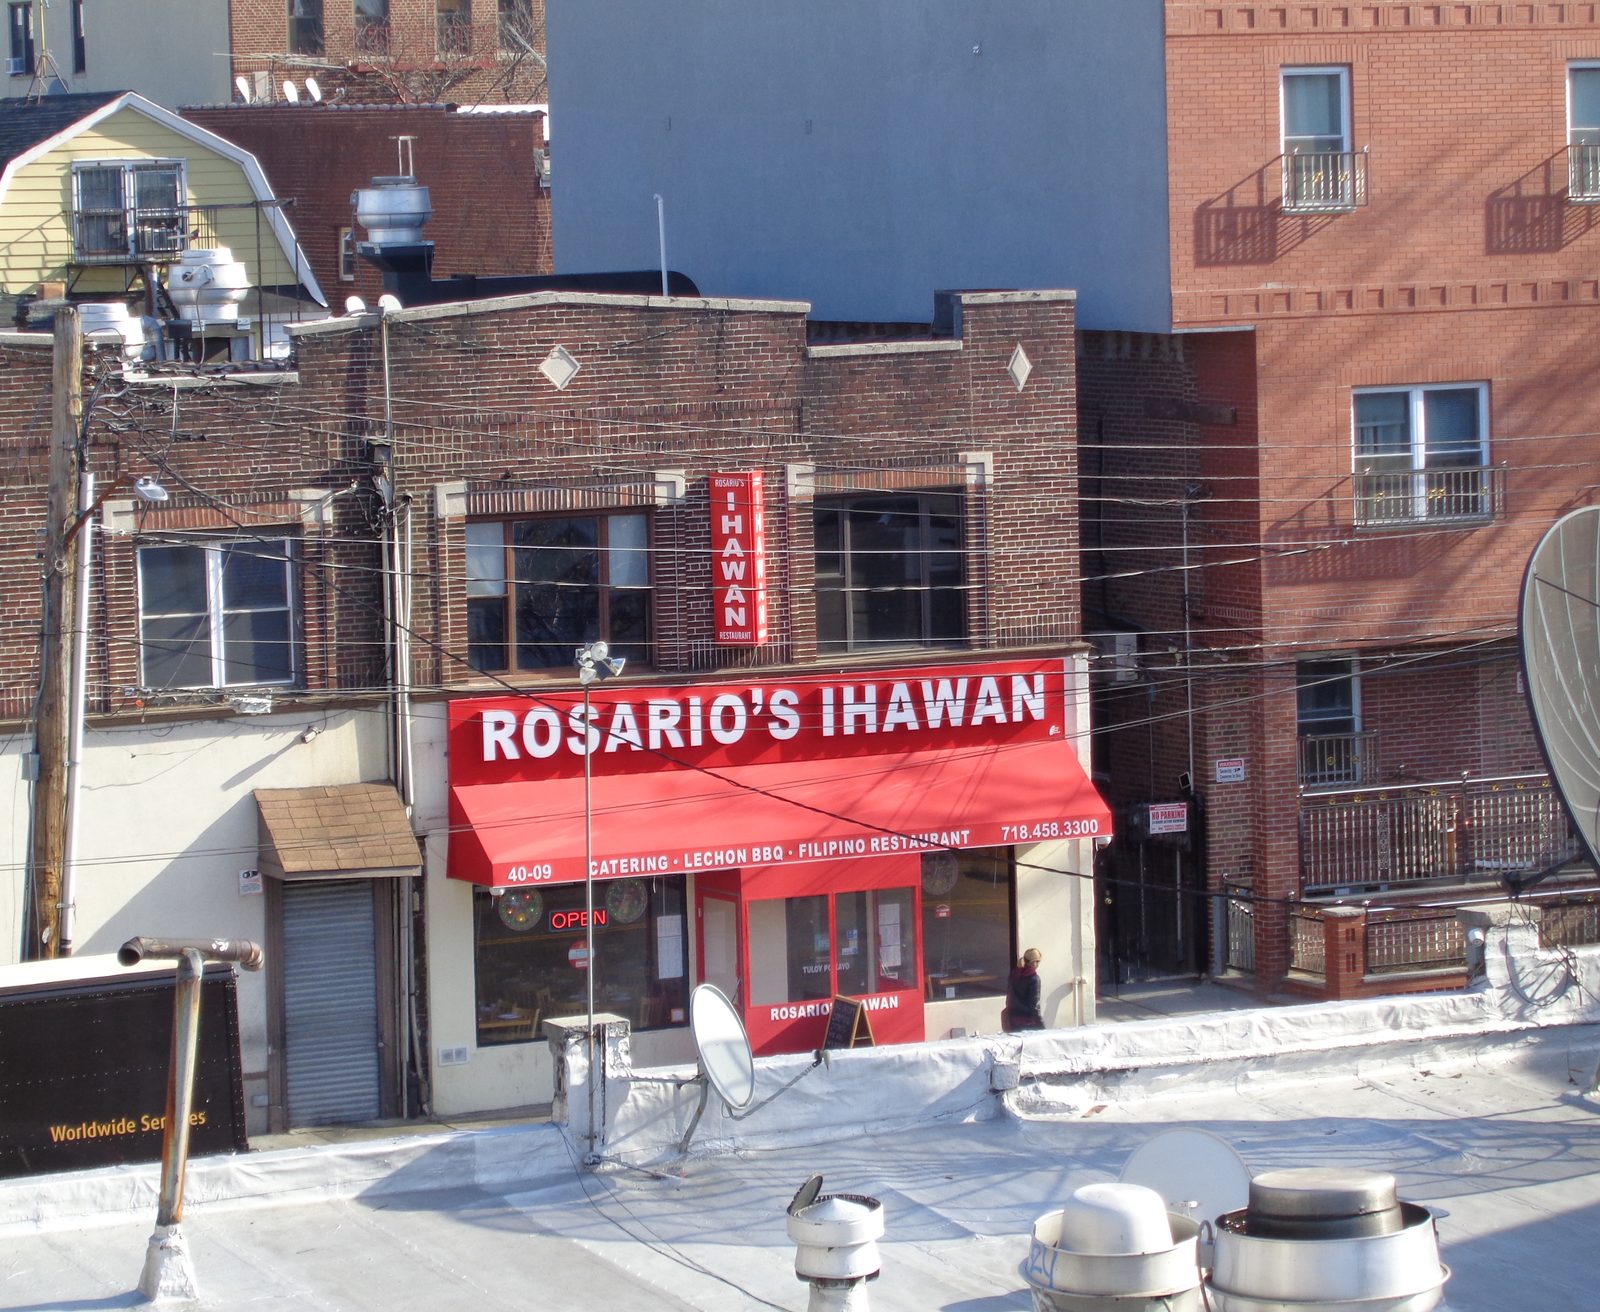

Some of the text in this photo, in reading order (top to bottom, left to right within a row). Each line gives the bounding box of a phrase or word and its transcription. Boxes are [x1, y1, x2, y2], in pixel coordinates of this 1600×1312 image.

[714, 478, 745, 488] ROSARIO'S
[721, 491, 747, 627] IHAWAN
[719, 631, 752, 640] RESTAURANT
[481, 673, 1046, 762] ROSARIO'S IHAWAN
[1151, 809, 1185, 820] NO PARKING
[1000, 818, 1100, 841] 718.458.3300
[507, 829, 971, 883] 40-09 CATERING LECHON BBQ FILIPINO RESTAURANT
[551, 910, 608, 929] OPEN
[50, 1110, 207, 1143] Worldwide Seres
